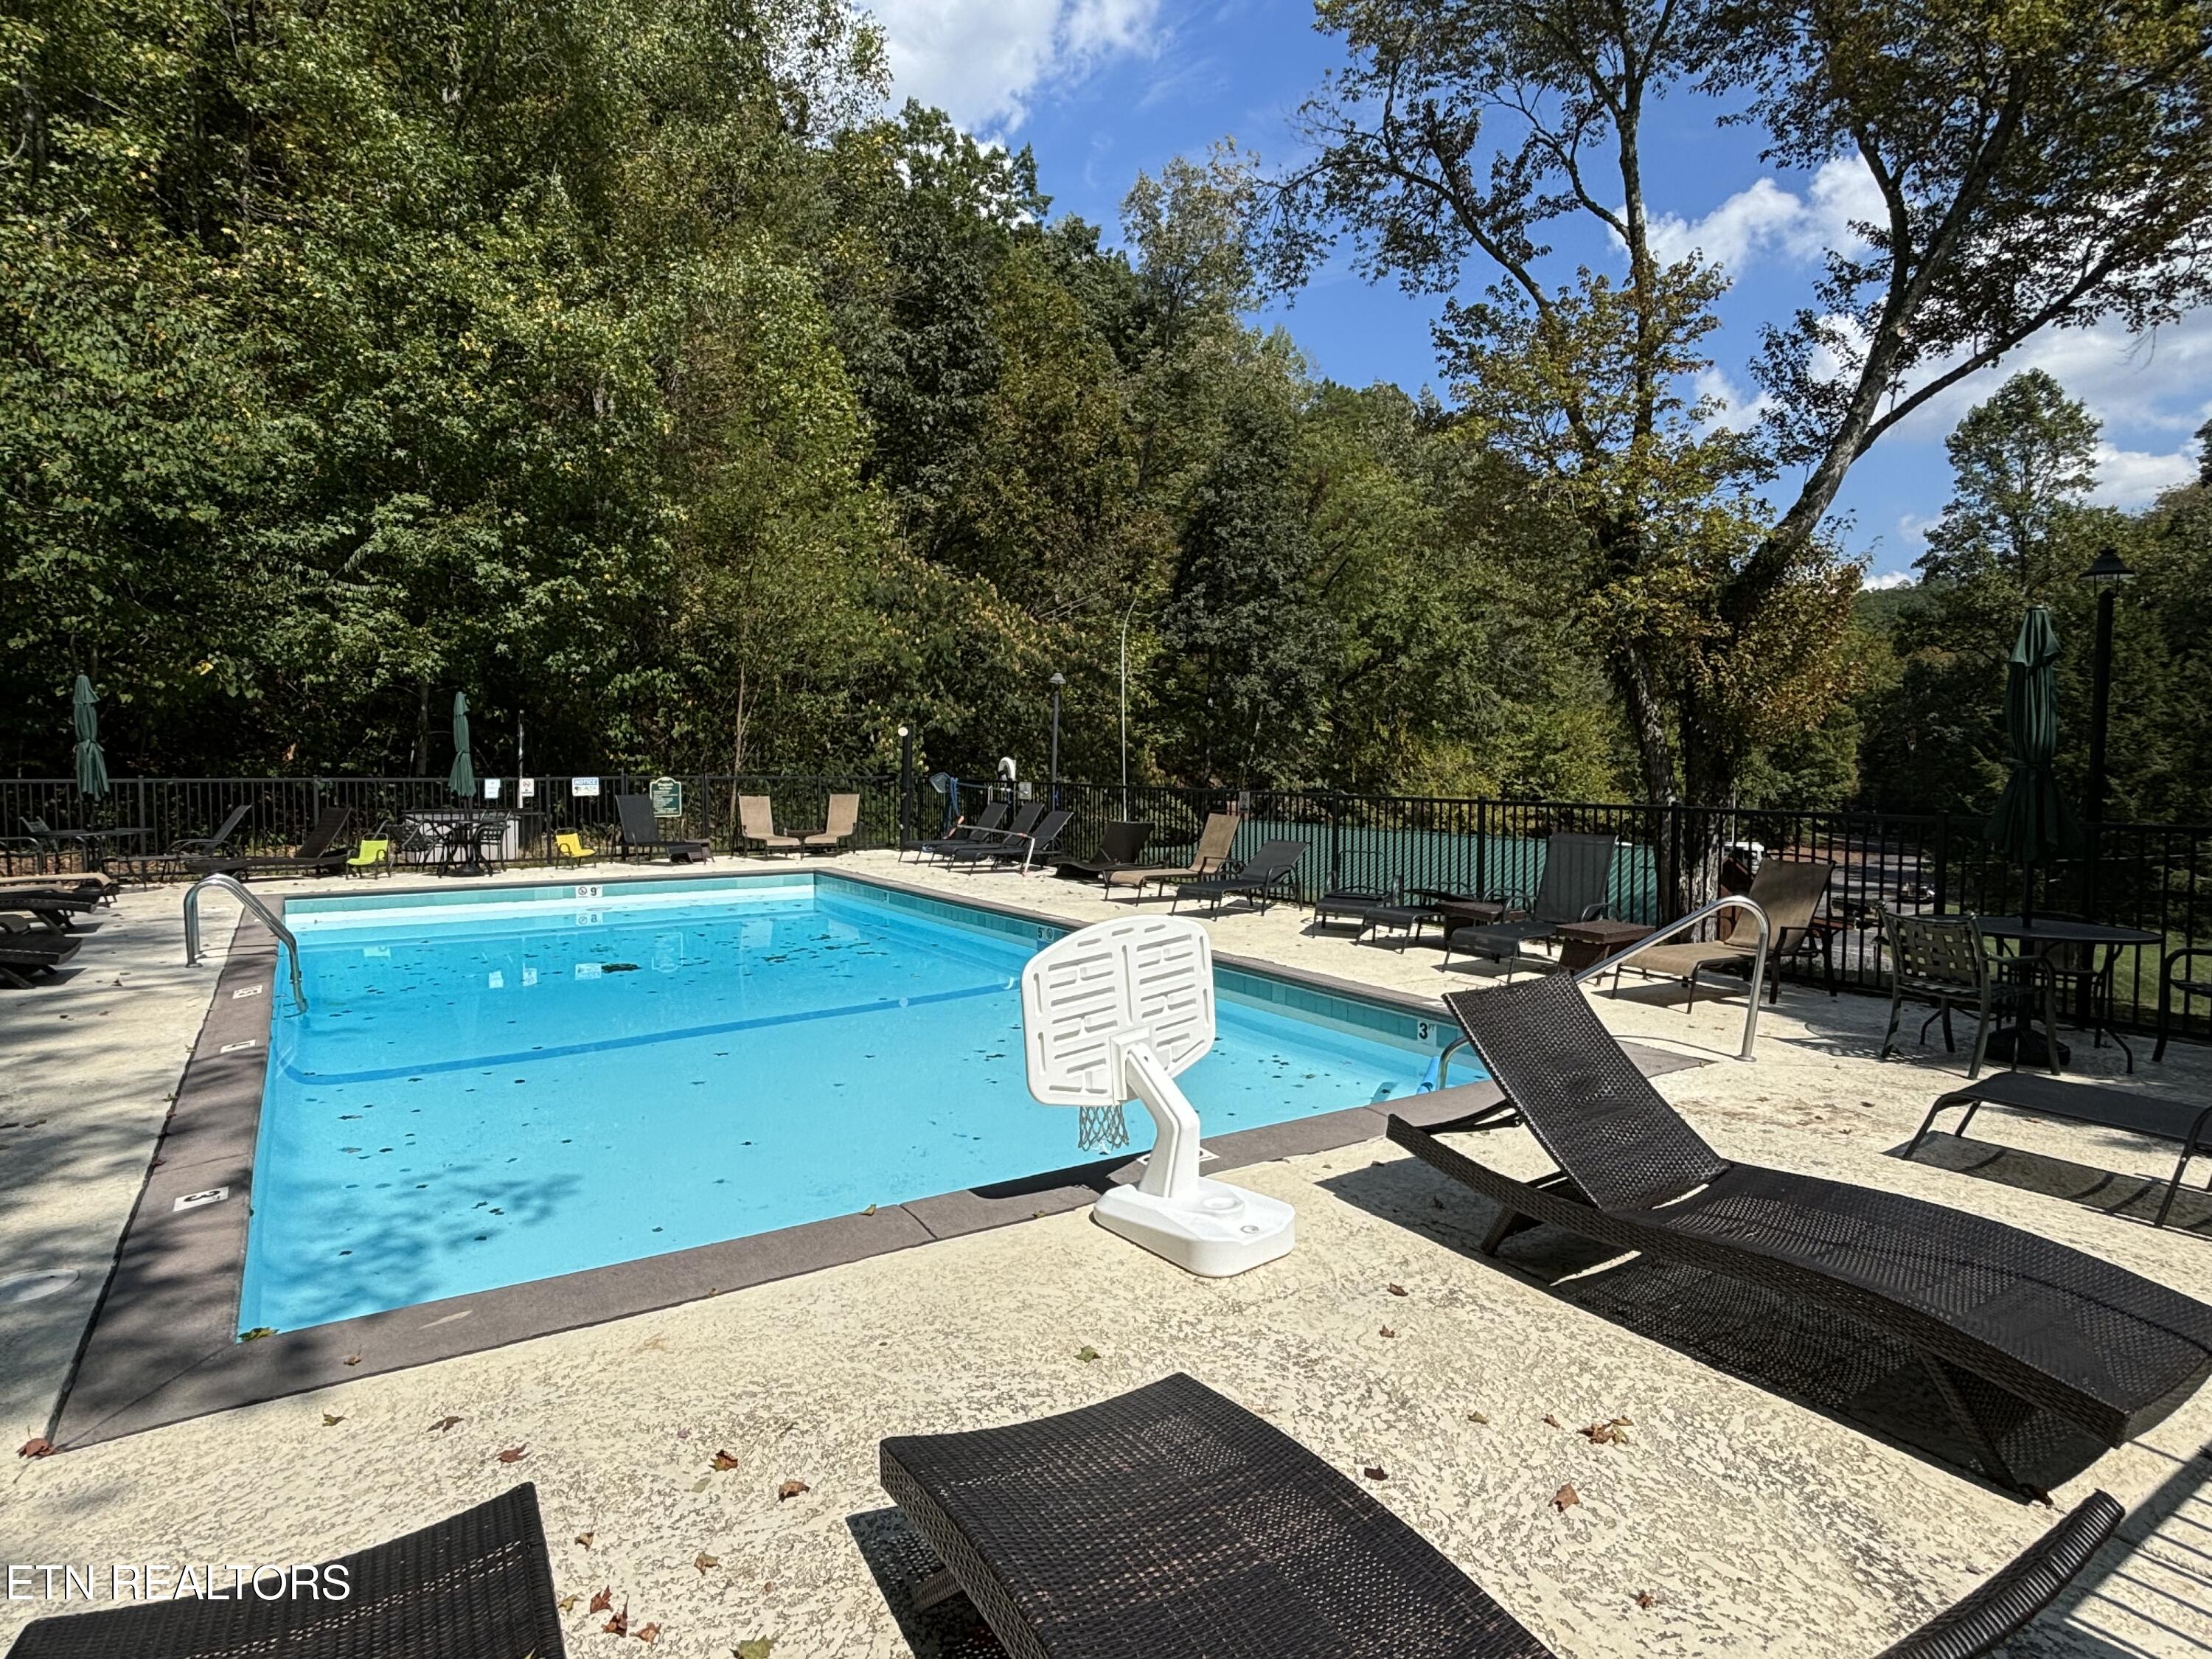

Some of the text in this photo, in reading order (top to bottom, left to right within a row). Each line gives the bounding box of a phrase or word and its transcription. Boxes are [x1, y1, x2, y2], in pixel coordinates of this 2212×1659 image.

[591, 887, 597, 897] 9
[1038, 926, 1043, 939] 5
[1419, 1022, 1428, 1040] 3
[184, 1191, 220, 1202] 3
